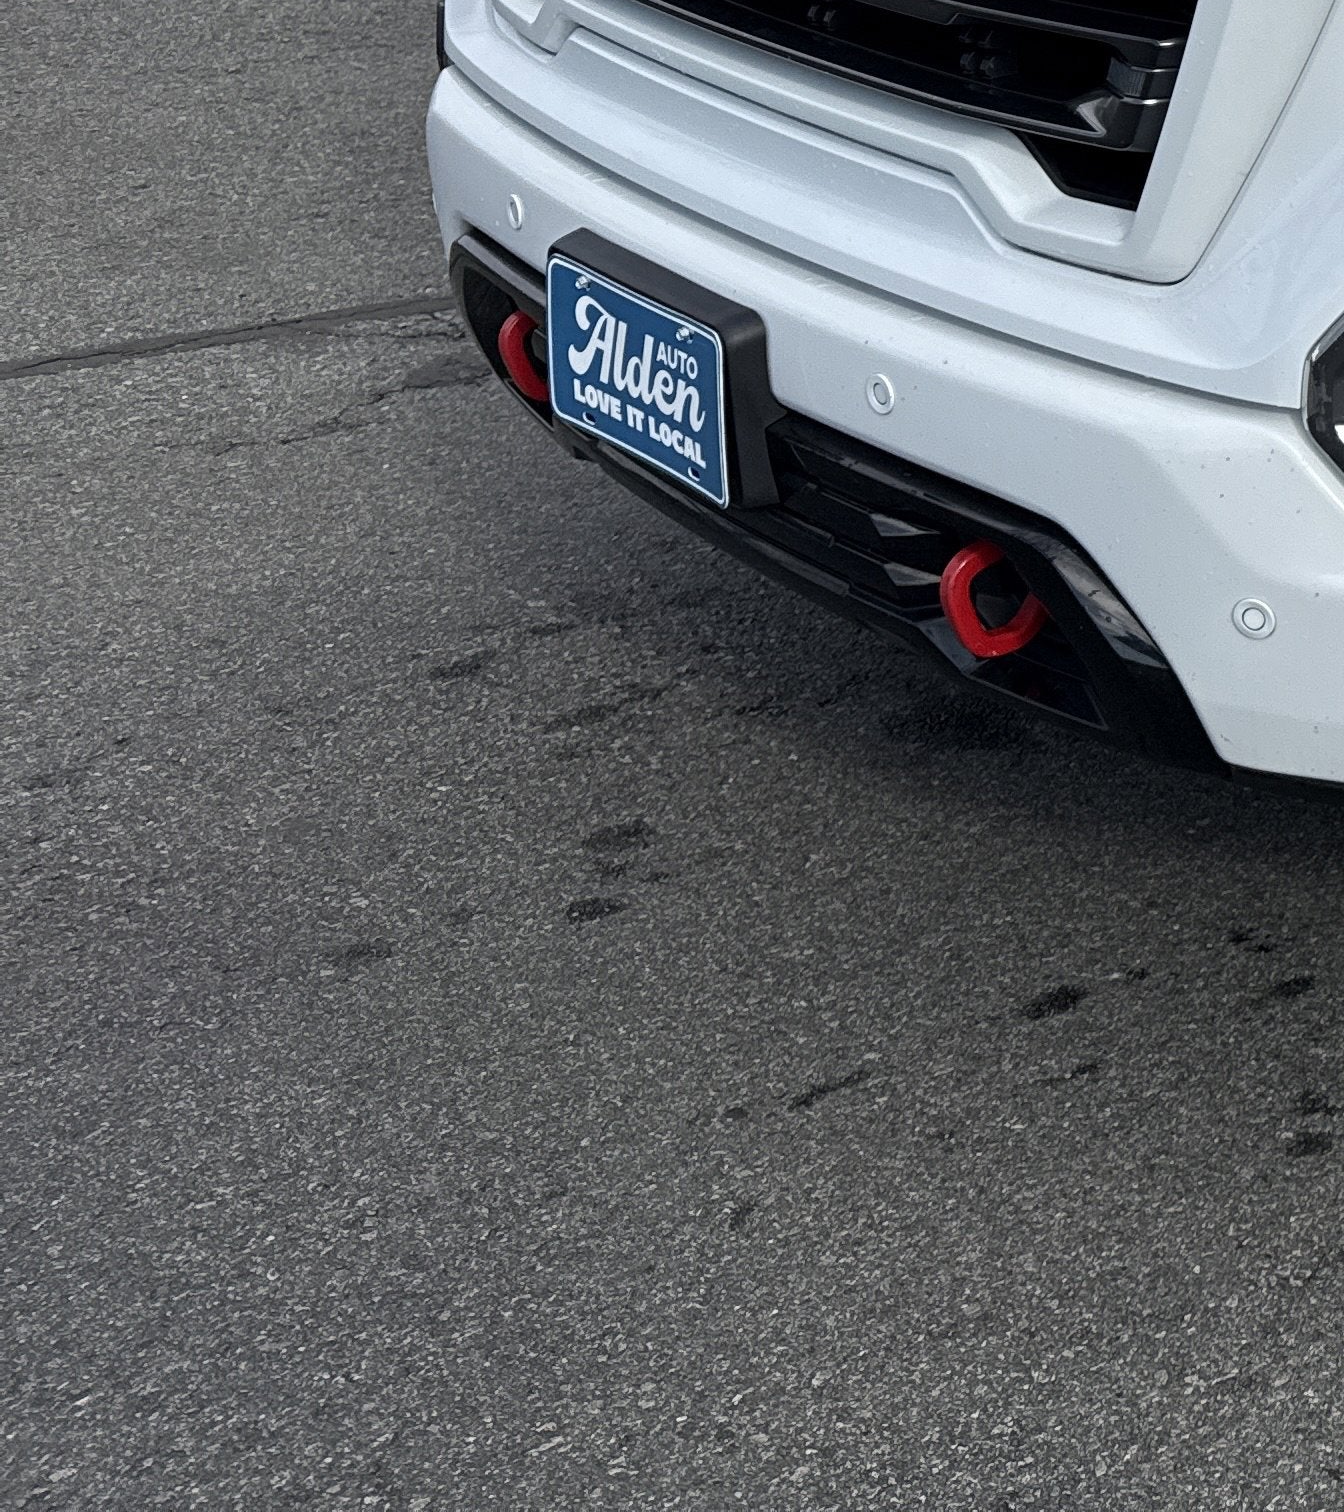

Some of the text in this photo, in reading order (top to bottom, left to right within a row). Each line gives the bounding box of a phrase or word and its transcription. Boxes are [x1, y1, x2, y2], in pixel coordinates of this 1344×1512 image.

[567, 295, 706, 432] Alden
[655, 341, 699, 380] AUTO
[573, 378, 707, 469] LOVE IT LOCAL
